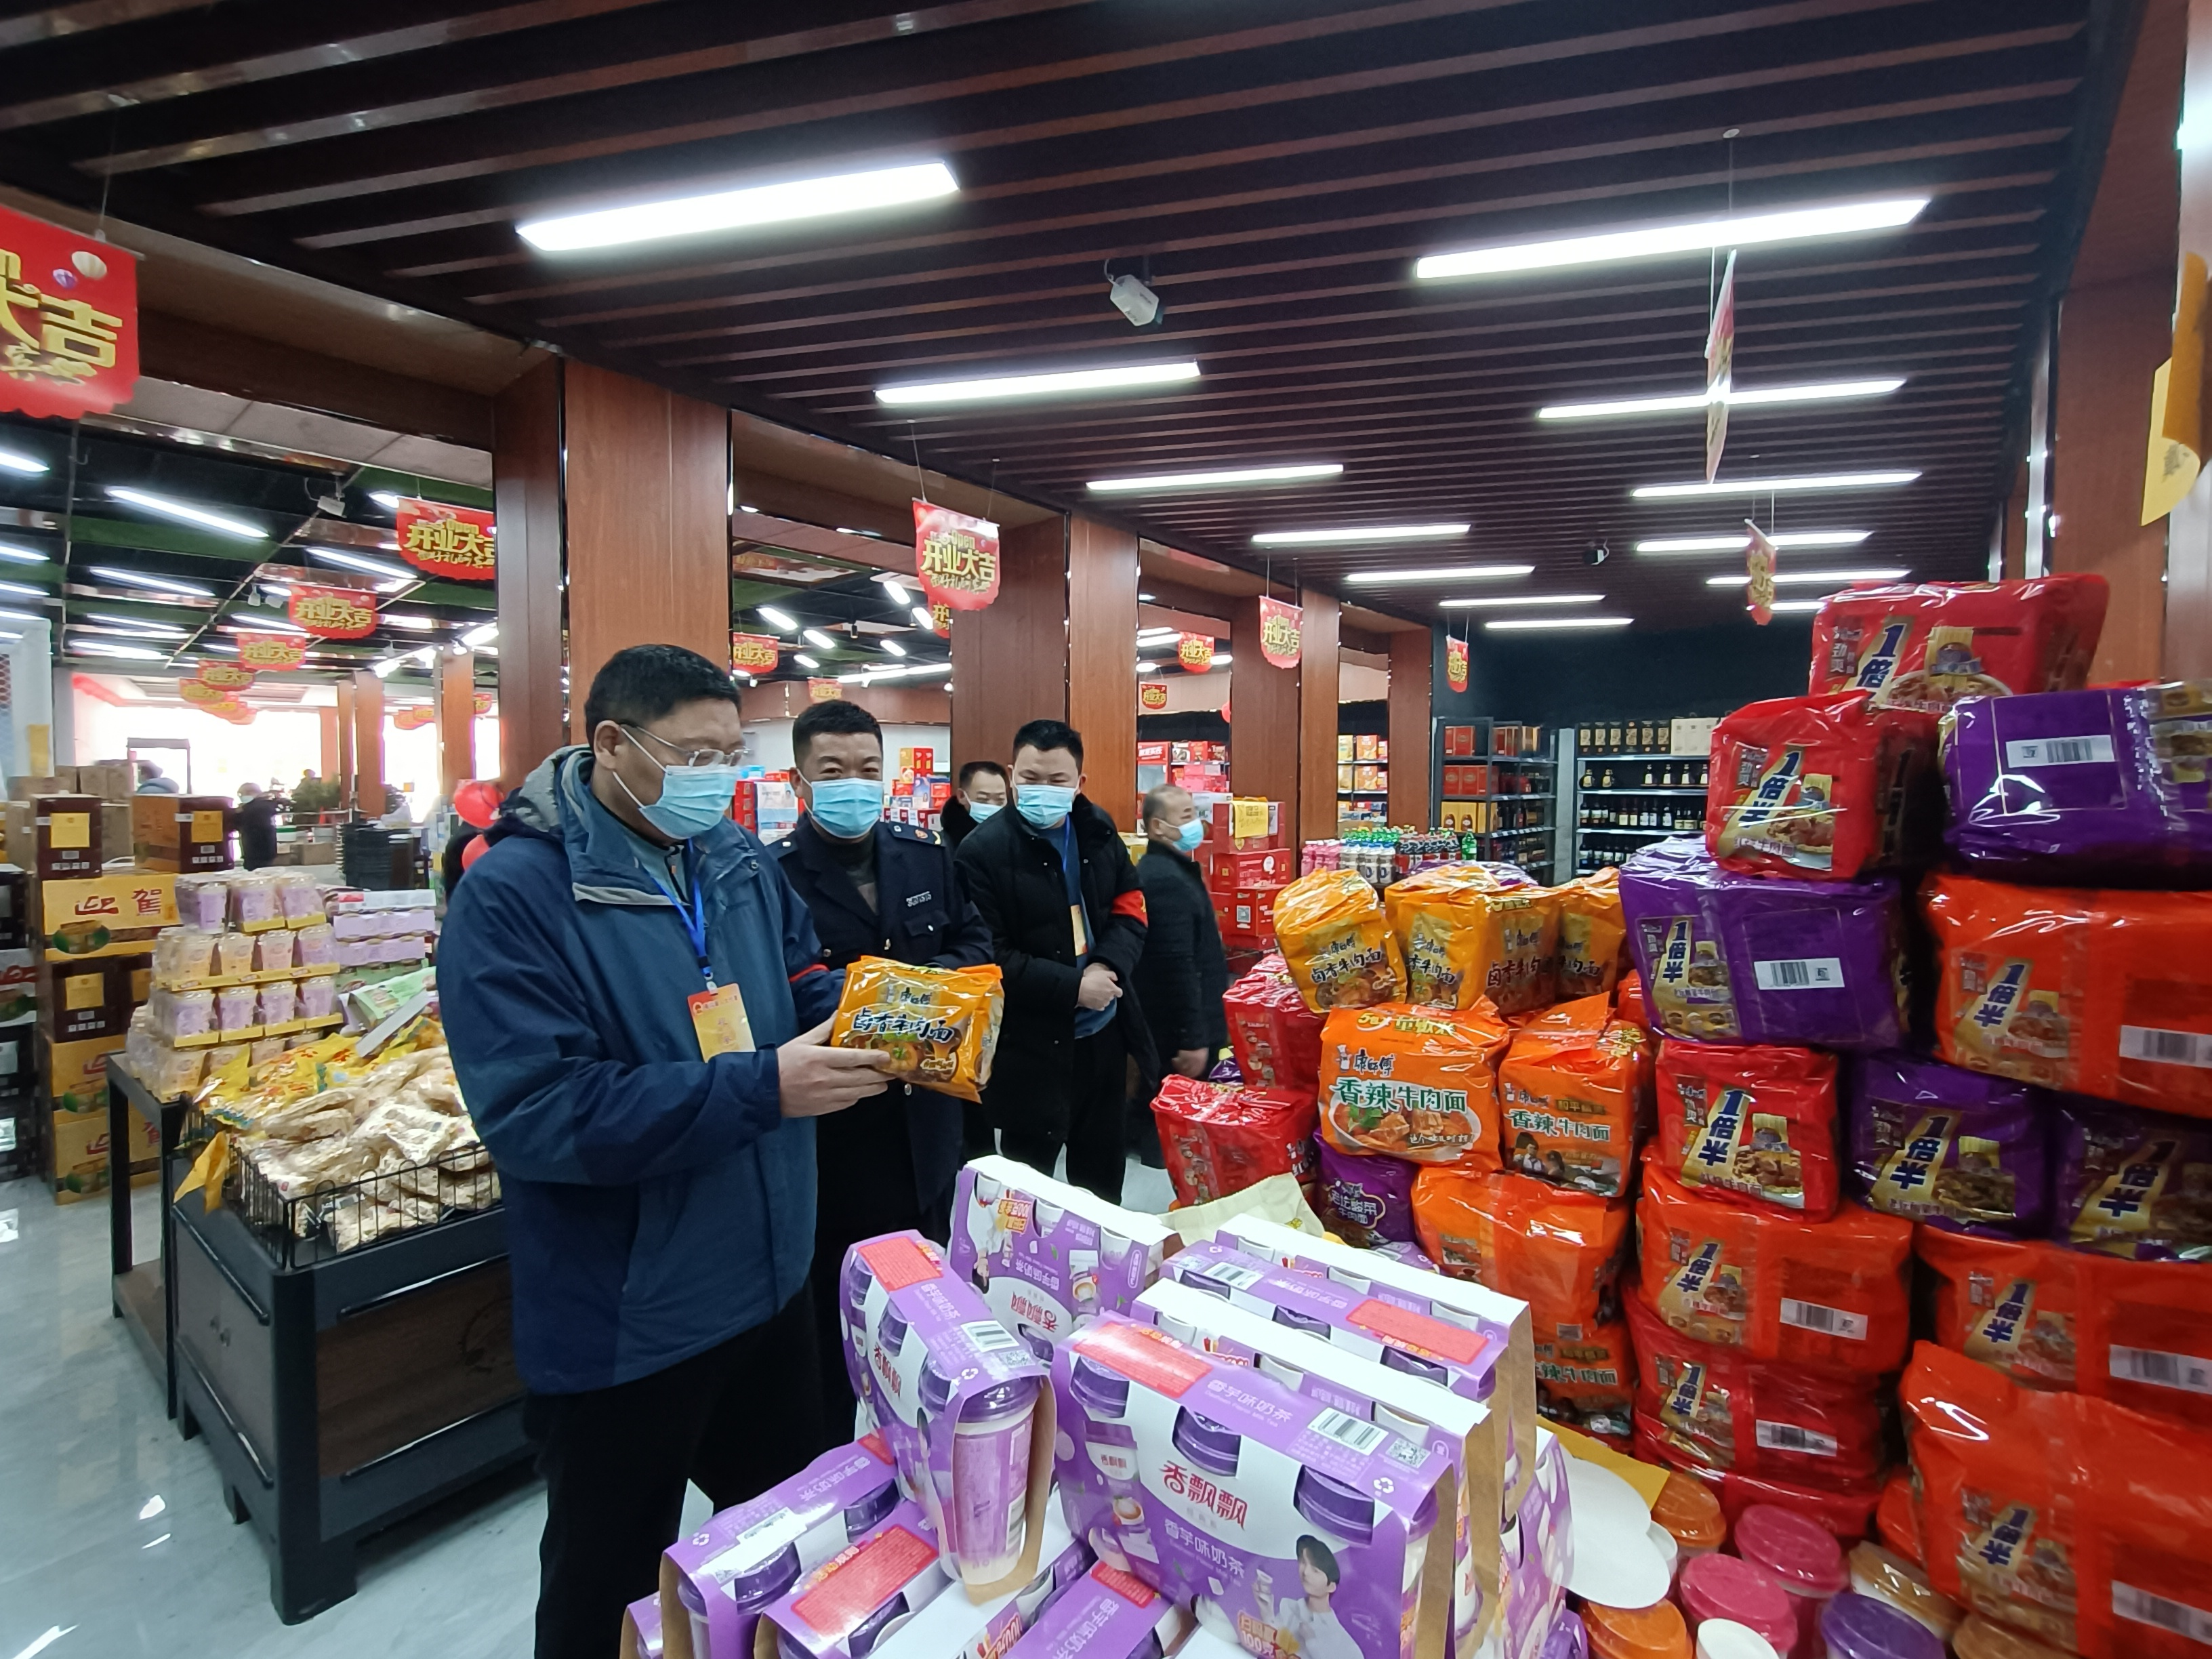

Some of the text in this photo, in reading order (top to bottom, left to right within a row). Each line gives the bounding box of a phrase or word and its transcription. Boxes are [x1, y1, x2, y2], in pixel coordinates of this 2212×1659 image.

[407, 525, 495, 557] 开业大吉
[920, 539, 996, 581] 开业大吉
[295, 602, 372, 625] 开业大吉
[243, 645, 303, 665] 开业大吉
[734, 646, 775, 661] 开业大吉
[1180, 644, 1212, 659] 开业大吉
[1262, 623, 1300, 650] 开业大吉
[1738, 751, 1802, 828] 1倍半
[1311, 947, 1382, 984] 卤香牛肉面
[1662, 921, 1689, 983] 1倍半
[1973, 964, 2025, 1028] 1倍半
[853, 1008, 954, 1044] 卤香牛肉面
[1354, 1048, 1396, 1077] 康师傅
[1330, 1076, 1467, 1113] 香辣牛肉面
[1504, 1108, 1611, 1141] 香辣牛肉面
[1698, 1090, 1744, 1166] 1倍半
[1889, 1117, 1950, 1190] 1倍半
[1331, 1189, 1377, 1216] 老坛酸菜
[1015, 1259, 1061, 1292] 香芋味奶茶
[1677, 1243, 1719, 1293] 1倍半
[1010, 1290, 1059, 1333] 香飘飘
[1982, 1283, 2030, 1343] 1倍半
[1207, 1379, 1293, 1424] 香芋味奶茶
[1671, 1365, 1701, 1416] 1倍半
[1159, 1460, 1248, 1531] 香飘飘
[1164, 1518, 1245, 1578] 香芋味奶茶
[1979, 1509, 2029, 1566] 1倍半
